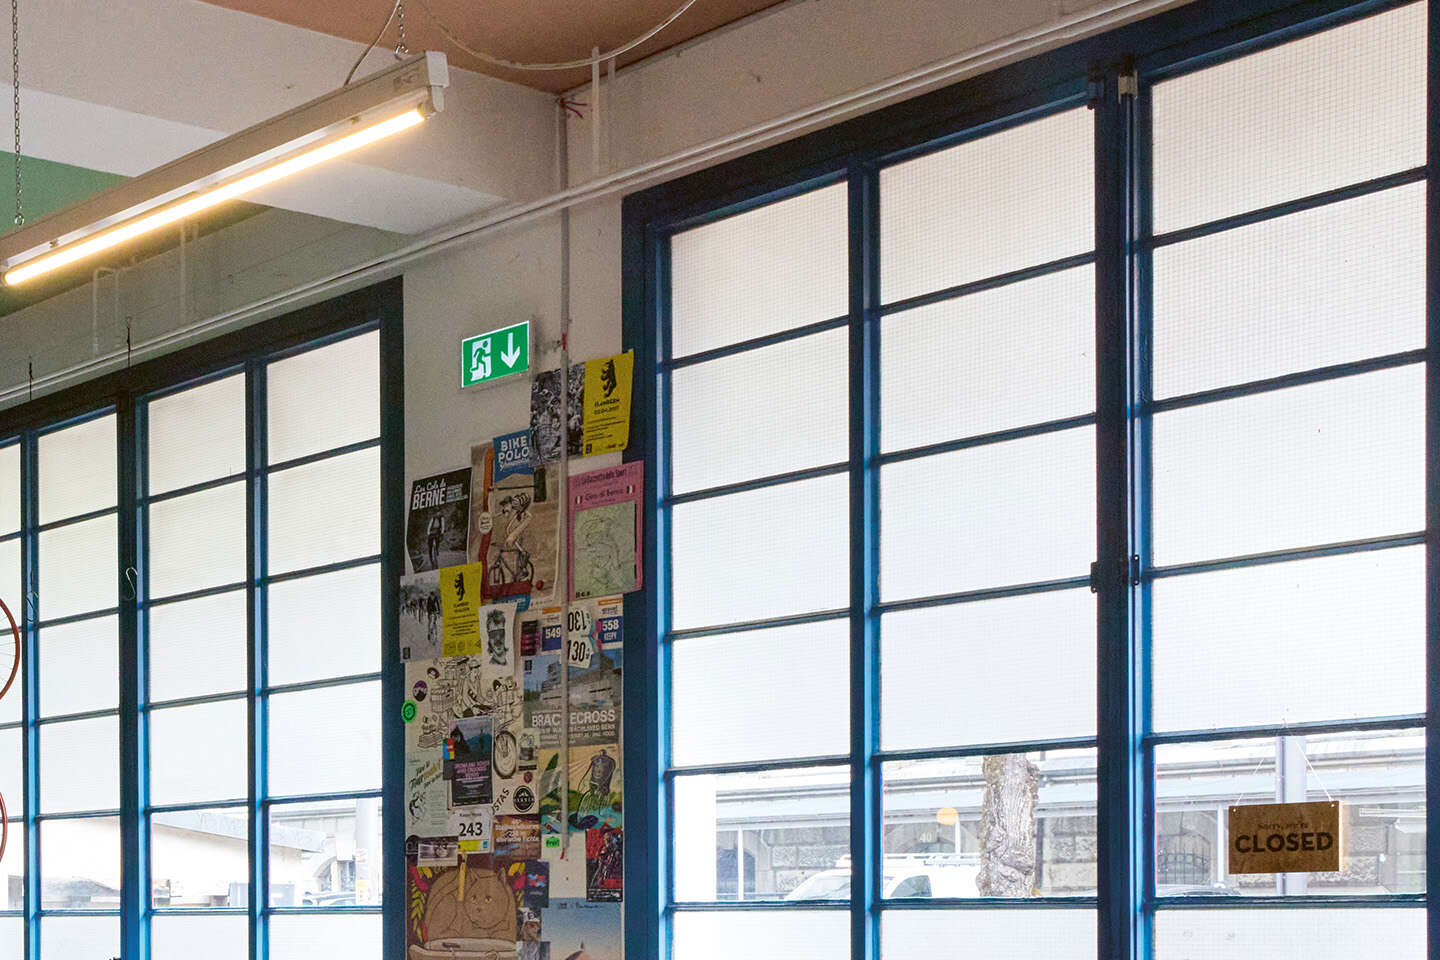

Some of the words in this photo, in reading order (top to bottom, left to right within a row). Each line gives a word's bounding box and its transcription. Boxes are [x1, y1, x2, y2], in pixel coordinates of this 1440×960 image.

[500, 436, 527, 451] BIKE
[498, 446, 529, 463] POLO
[412, 487, 446, 511] BERNE
[602, 618, 619, 632] 558
[545, 627, 560, 639] 549
[458, 822, 483, 837] 243
[1235, 832, 1334, 853] CLOSED
